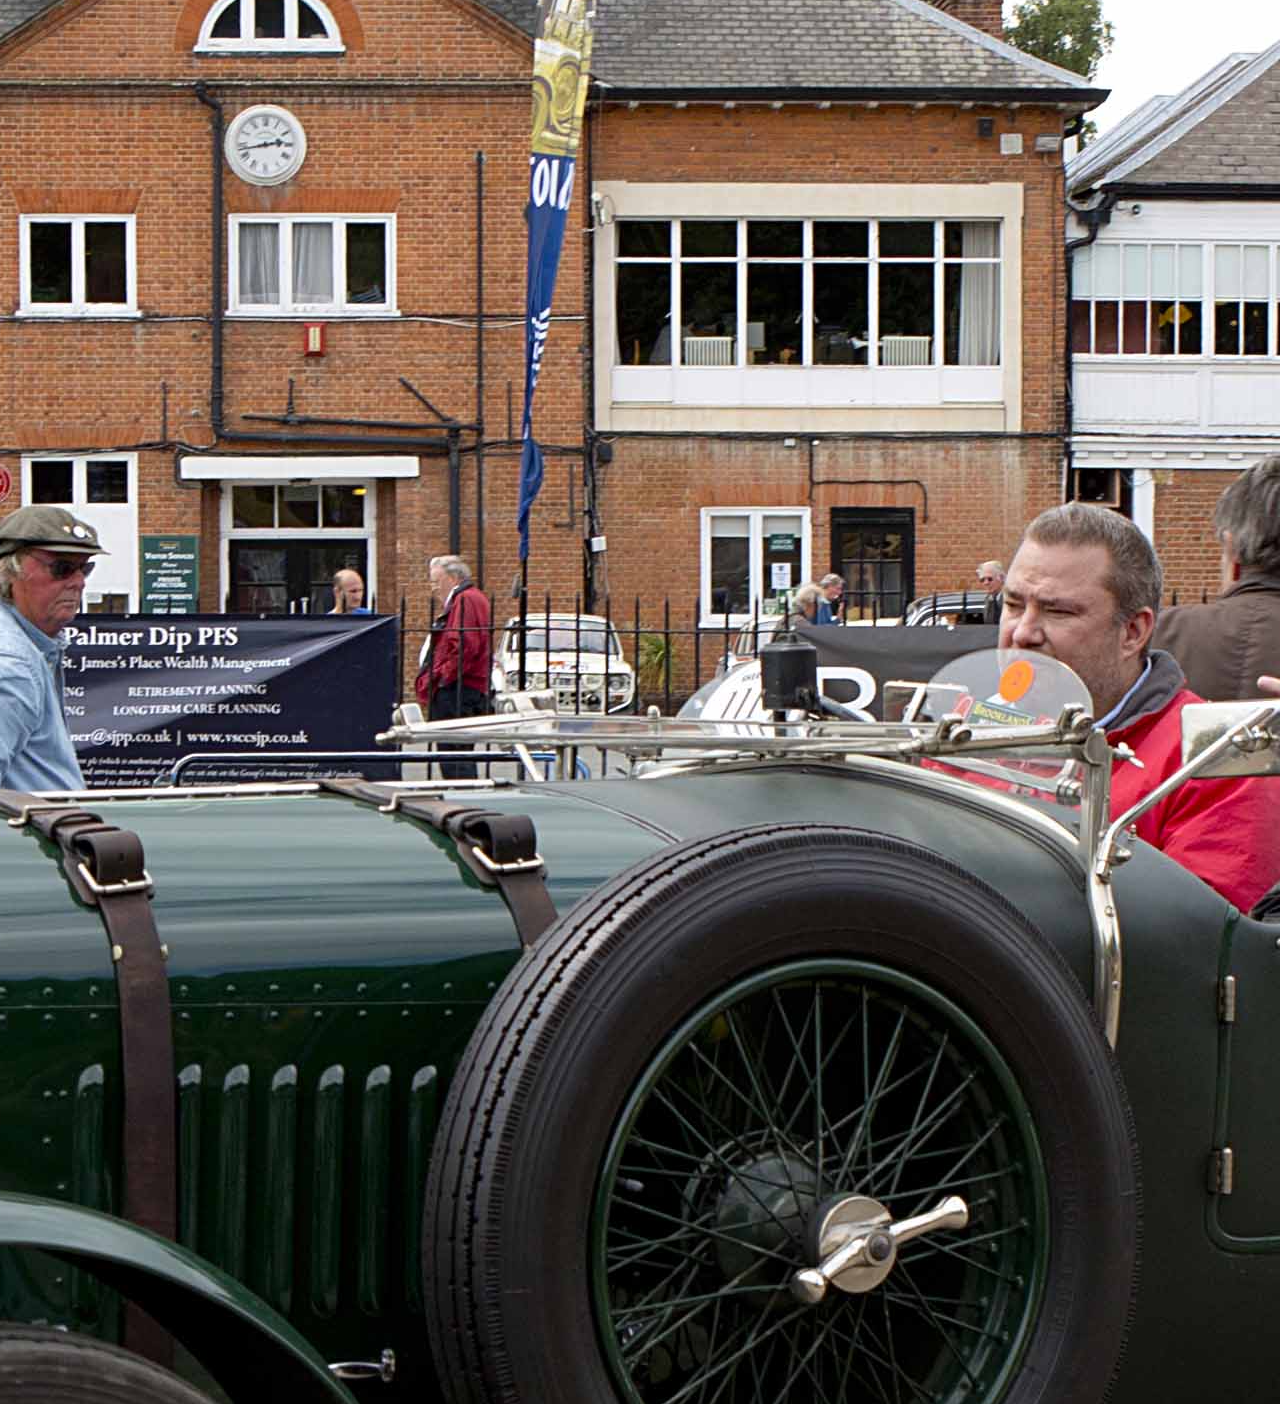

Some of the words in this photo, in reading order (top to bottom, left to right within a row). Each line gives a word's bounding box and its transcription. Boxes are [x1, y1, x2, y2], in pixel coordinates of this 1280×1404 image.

[64, 625, 144, 647] Palmer
[148, 625, 192, 654] Dip
[197, 626, 239, 647] PFS
[80, 655, 127, 673] James's
[128, 656, 163, 670] Place
[163, 655, 209, 670] Wealth
[211, 656, 292, 674] Management
[127, 686, 204, 697] RETIREMENT
[205, 684, 267, 696] PLANNING
[183, 703, 216, 715] CARE
[218, 703, 281, 715] PLANNING
[187, 730, 309, 747] www.vsccsjp.co.uk
